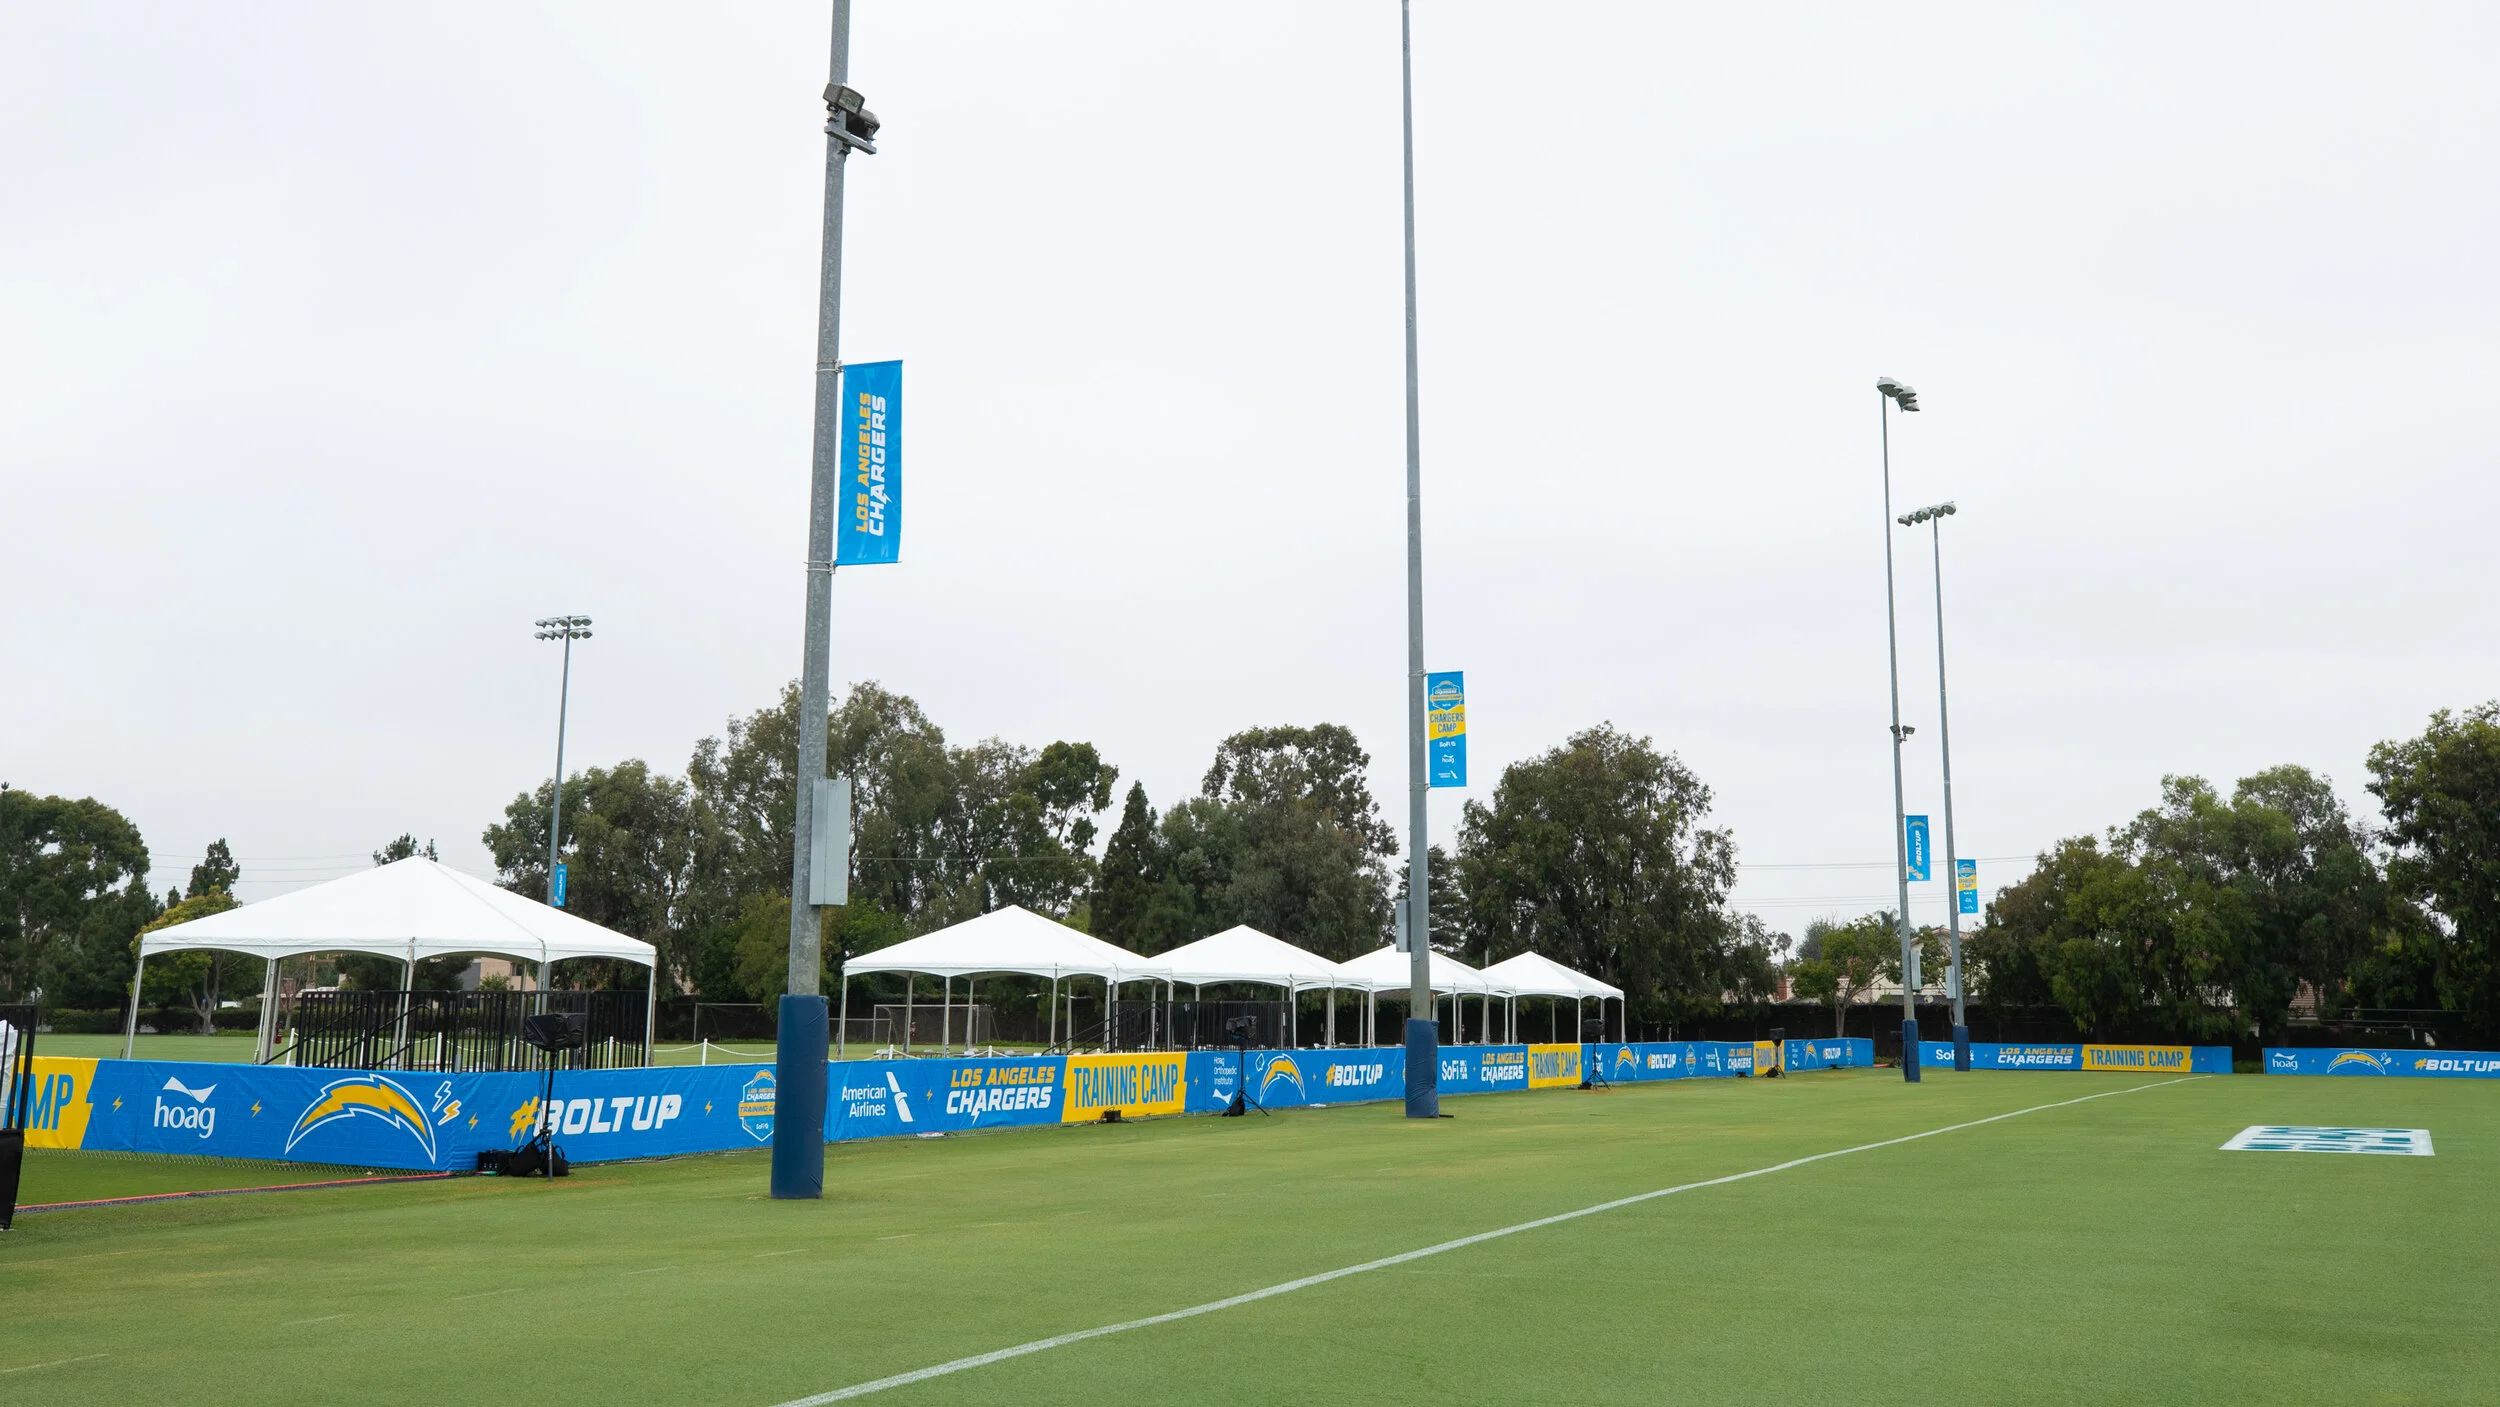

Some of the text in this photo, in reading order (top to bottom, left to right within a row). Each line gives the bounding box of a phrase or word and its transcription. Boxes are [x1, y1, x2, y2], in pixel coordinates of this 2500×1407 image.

[856, 393, 871, 533] LOS ANGELES
[869, 395, 891, 536] CHARGERS
[1430, 712, 1464, 723] CHARGERS
[1437, 723, 1457, 733] CAMP
[1482, 1052, 1525, 1065] LOS ANGELES
[1531, 1051, 1578, 1079] TRAINING CAMP
[1647, 1053, 1677, 1069] #BOLTUP
[1727, 1057, 1752, 1070] CHARGERS
[1997, 1055, 2073, 1067] CHARGERS
[2089, 1049, 2184, 1067] TRAINING CAMP
[2272, 1058, 2298, 1071] hoag
[2414, 1058, 2500, 1072] #BOLTUP
[951, 1066, 1056, 1088] LOS ANGELES
[1326, 1063, 1383, 1087] #BOLTUP
[1441, 1060, 1459, 1081] SoFi
[1481, 1065, 1524, 1086] CHARGERS
[842, 1084, 886, 1102] American
[1074, 1063, 1179, 1108] TRAINING CAMP
[3, 1073, 74, 1130] AMP
[746, 1093, 776, 1102] CHARGER
[946, 1086, 1053, 1121] CHARGERS
[153, 1095, 216, 1139] hoag
[740, 1105, 768, 1113] TRAINING
[849, 1101, 886, 1118] Airlines
[509, 1095, 682, 1145] #BOLTUP
